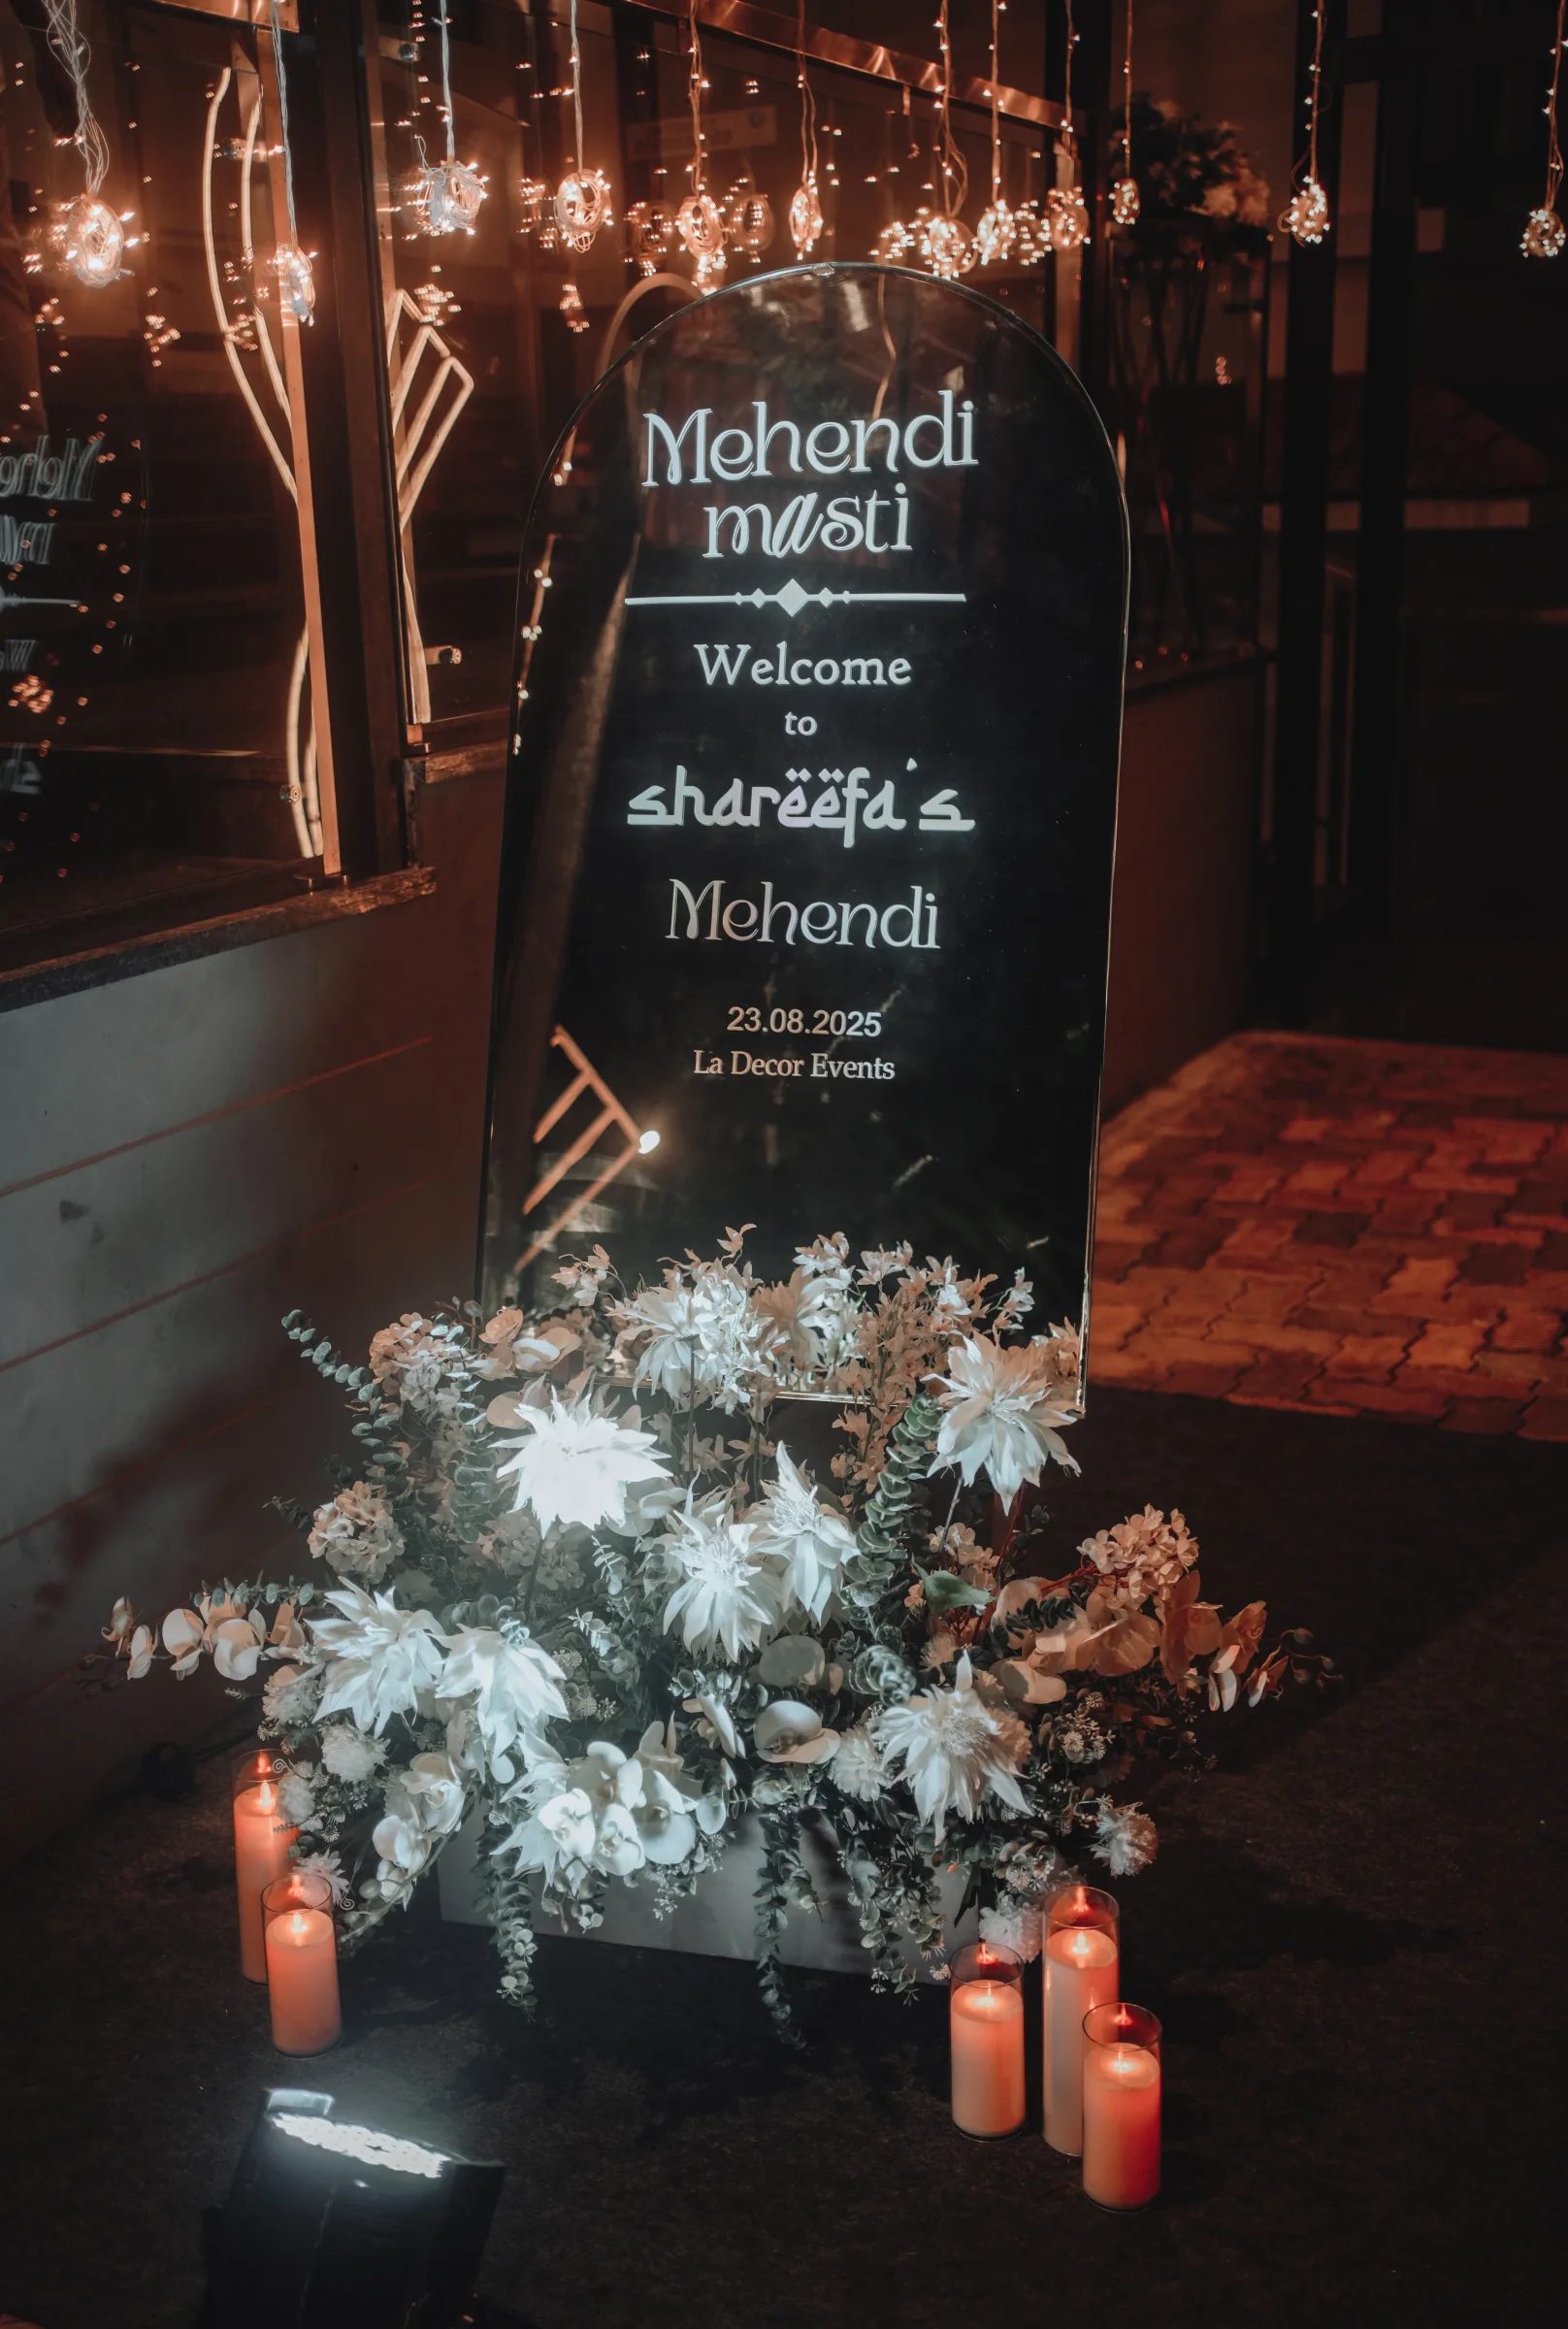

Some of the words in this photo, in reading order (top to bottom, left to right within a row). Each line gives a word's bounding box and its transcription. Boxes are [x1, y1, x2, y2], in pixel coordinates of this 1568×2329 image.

[641, 389, 979, 487] Mehendi
[702, 482, 913, 559] masti
[693, 640, 912, 686] Welcome
[784, 711, 818, 737] to
[665, 878, 941, 949] Mehendi
[727, 1006, 882, 1037] 23.08.2025
[693, 1049, 723, 1074] La
[730, 1050, 805, 1077] Decor
[809, 1052, 896, 1080] Events
